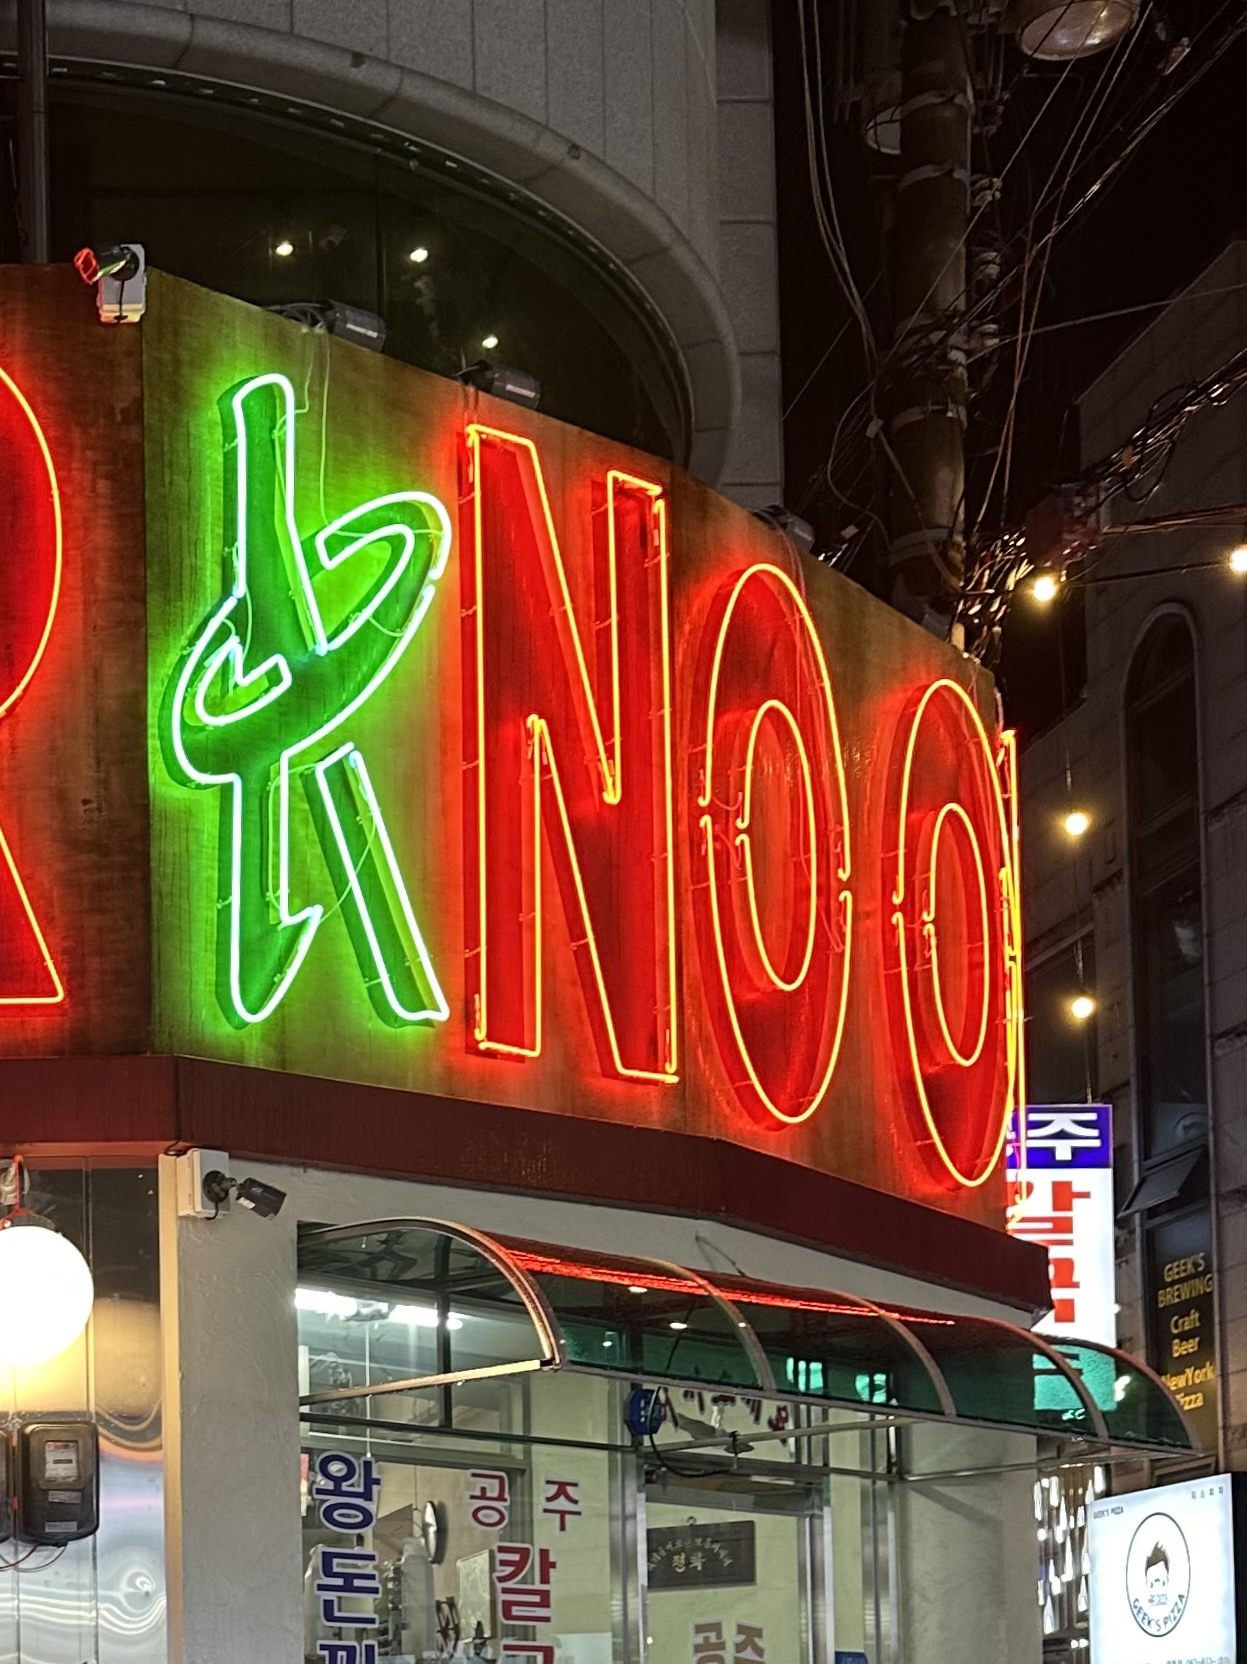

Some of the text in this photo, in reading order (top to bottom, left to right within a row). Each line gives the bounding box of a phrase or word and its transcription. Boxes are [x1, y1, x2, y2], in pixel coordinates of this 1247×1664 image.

[1163, 1253, 1205, 1282] GEEK'S
[1158, 1274, 1214, 1308] BREWING
[1170, 1309, 1201, 1334] Craft
[1172, 1337, 1201, 1358] Beer
[1163, 1593, 1186, 1629] PIZZA
